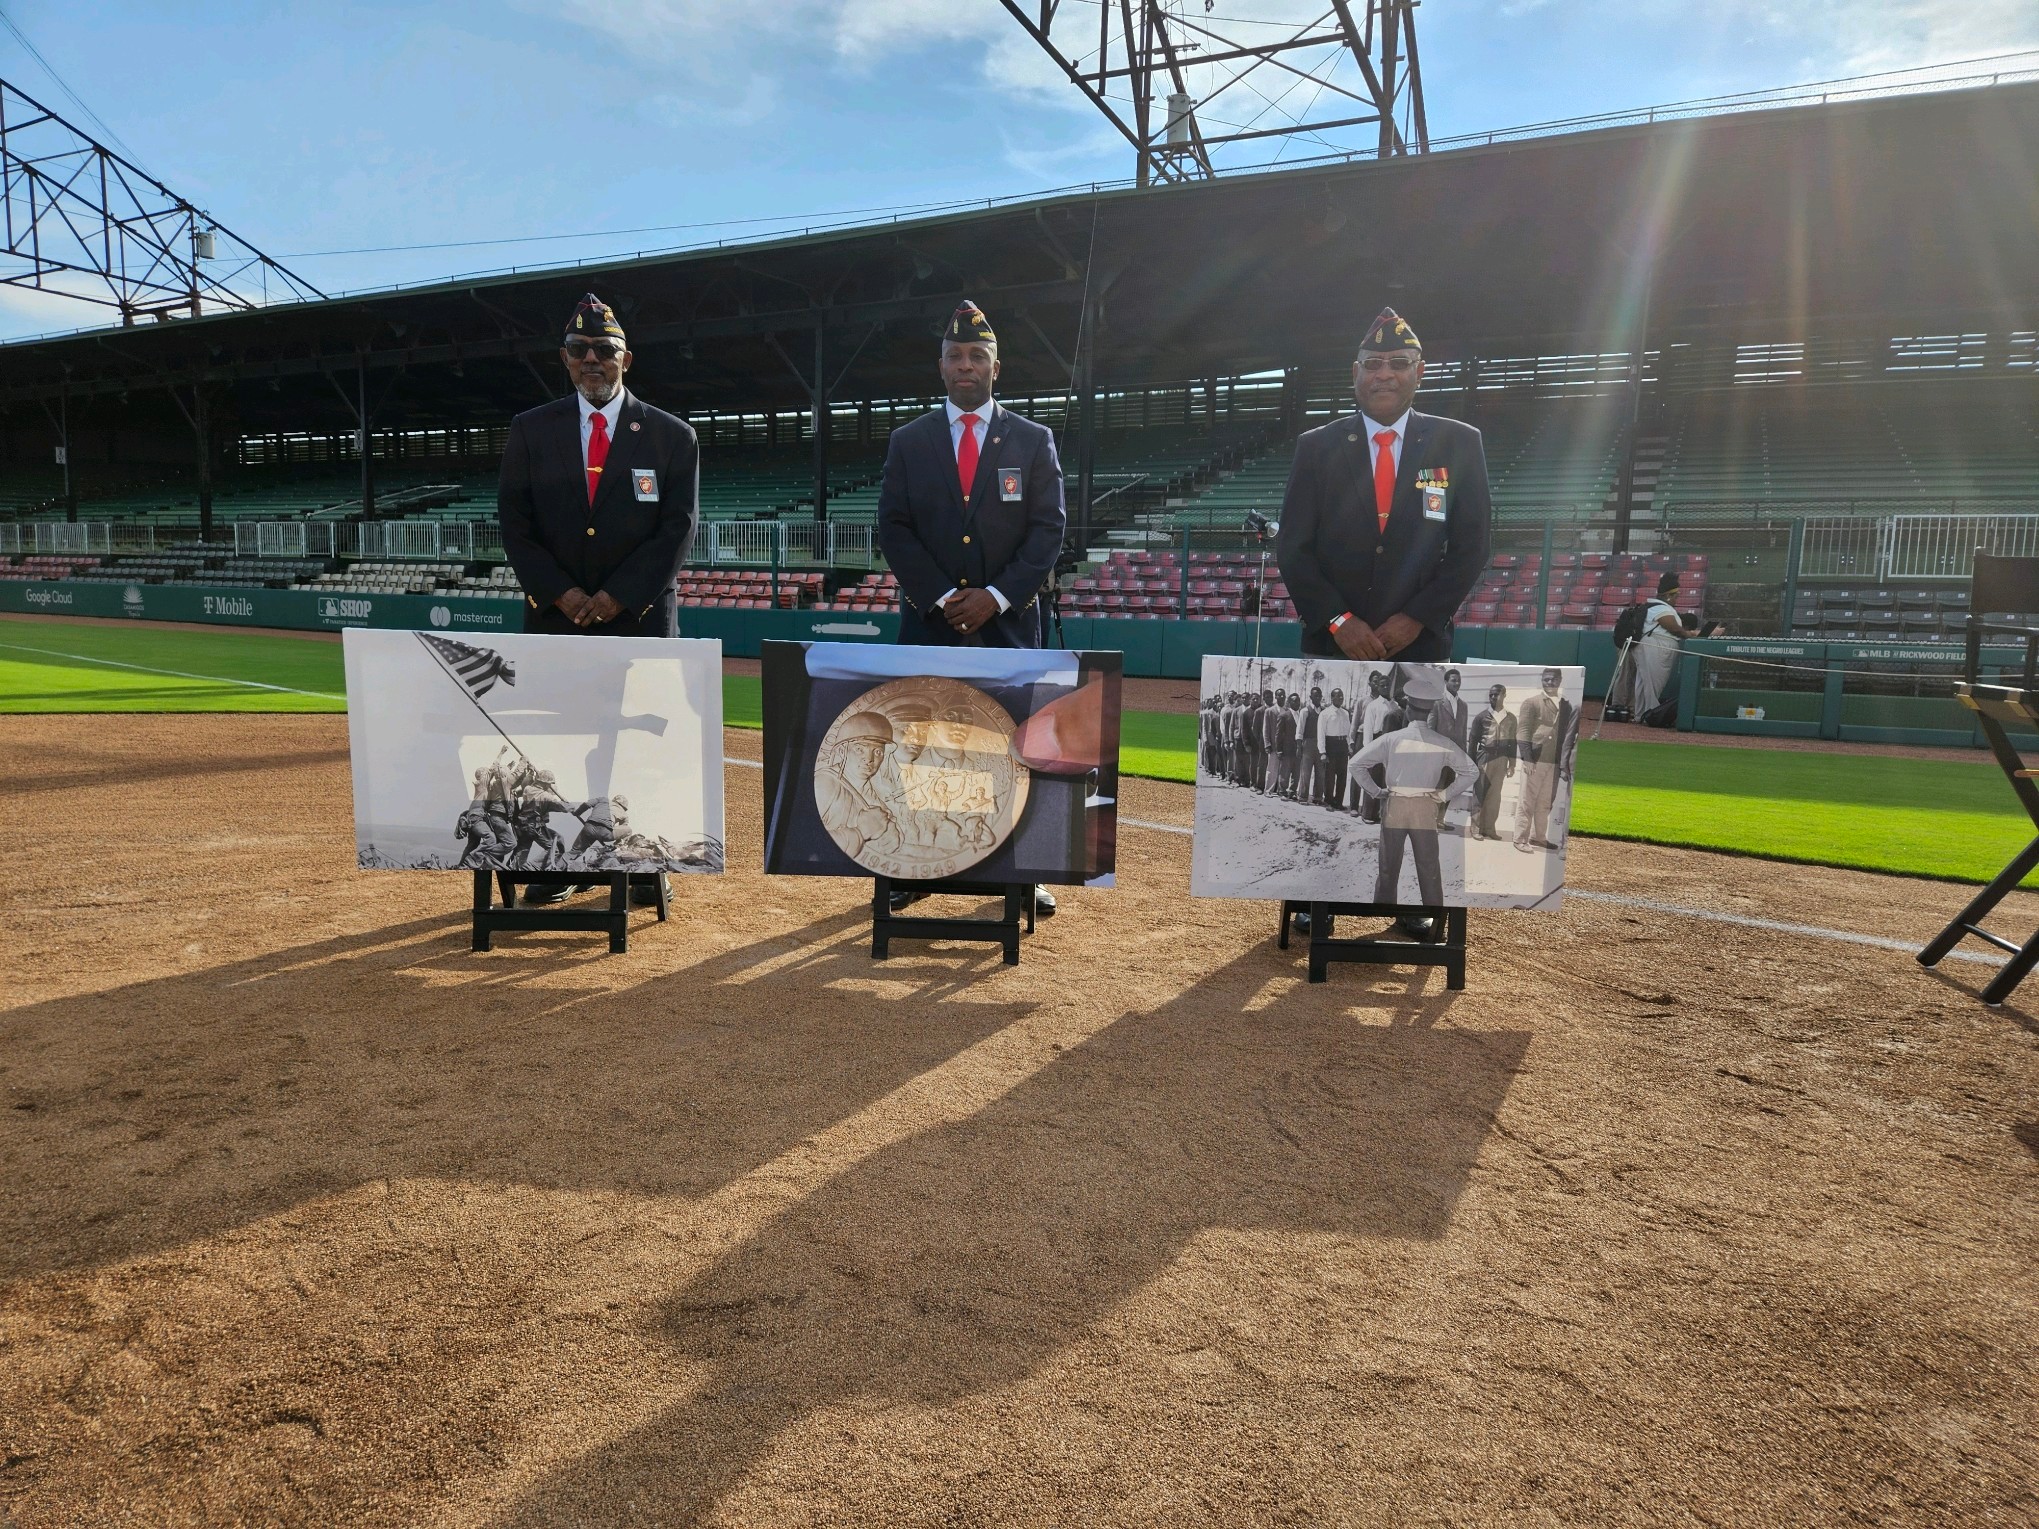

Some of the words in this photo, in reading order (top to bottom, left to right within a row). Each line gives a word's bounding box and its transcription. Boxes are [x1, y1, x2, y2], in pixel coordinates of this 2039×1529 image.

[26, 588, 51, 606] Google
[52, 590, 73, 604] Cloud
[216, 597, 253, 616] Mobile
[340, 599, 372, 617] SHOP
[453, 612, 502, 624] mastercard
[1731, 645, 1750, 653] TRIBUTE
[1757, 646, 1766, 654] THE
[1784, 647, 1804, 655] LEAGUES
[1900, 650, 1944, 660] RICKWOOD
[1946, 652, 1966, 660] FIELD
[859, 852, 901, 874] 1942
[910, 860, 956, 878] 1949
